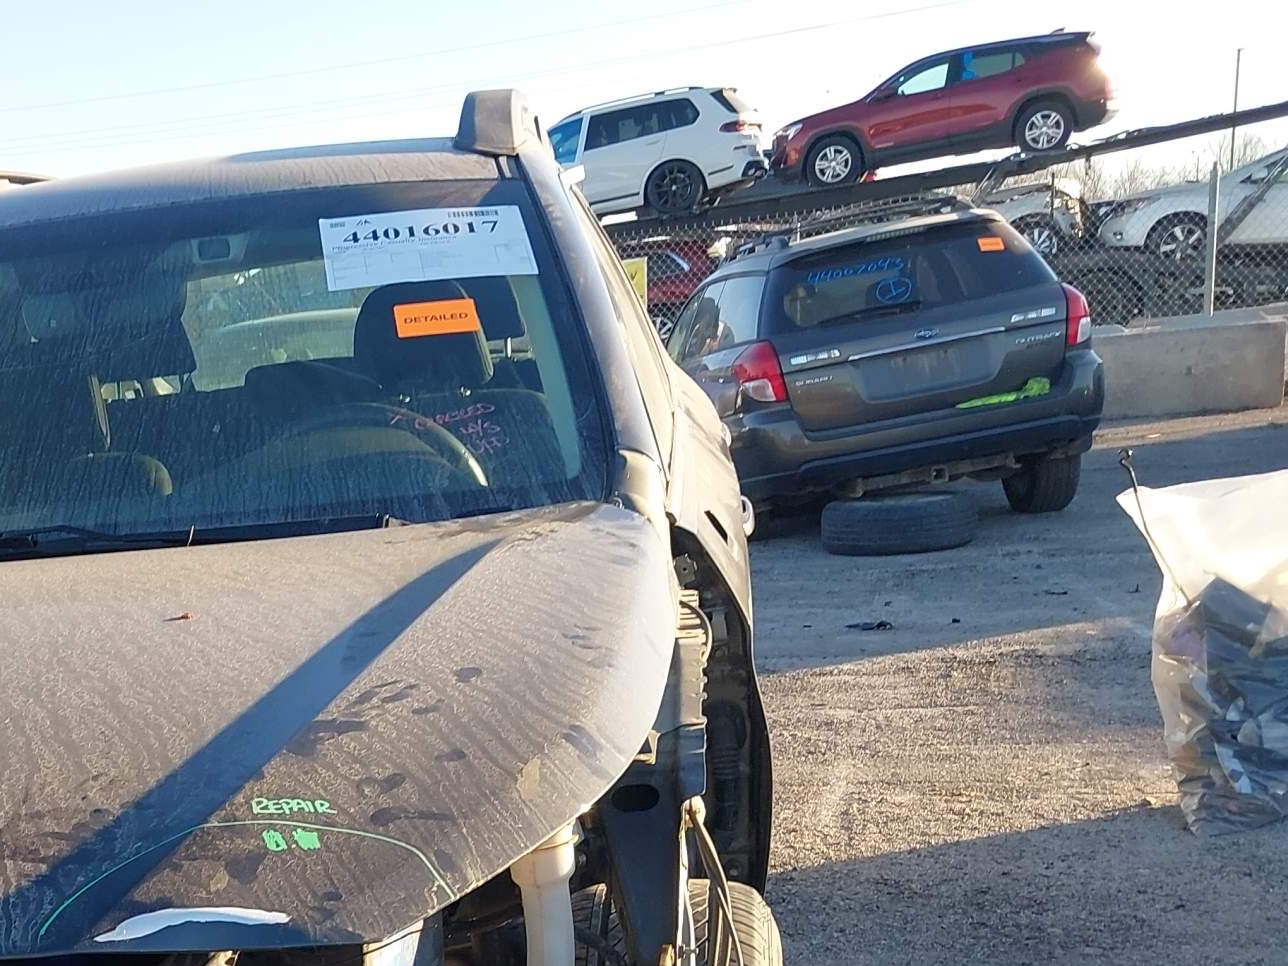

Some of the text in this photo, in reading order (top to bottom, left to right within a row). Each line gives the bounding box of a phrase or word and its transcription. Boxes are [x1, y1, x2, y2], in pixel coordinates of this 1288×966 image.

[343, 219, 500, 244] 44016017
[404, 312, 469, 325] DETAILED
[251, 797, 337, 815] REPAIR
